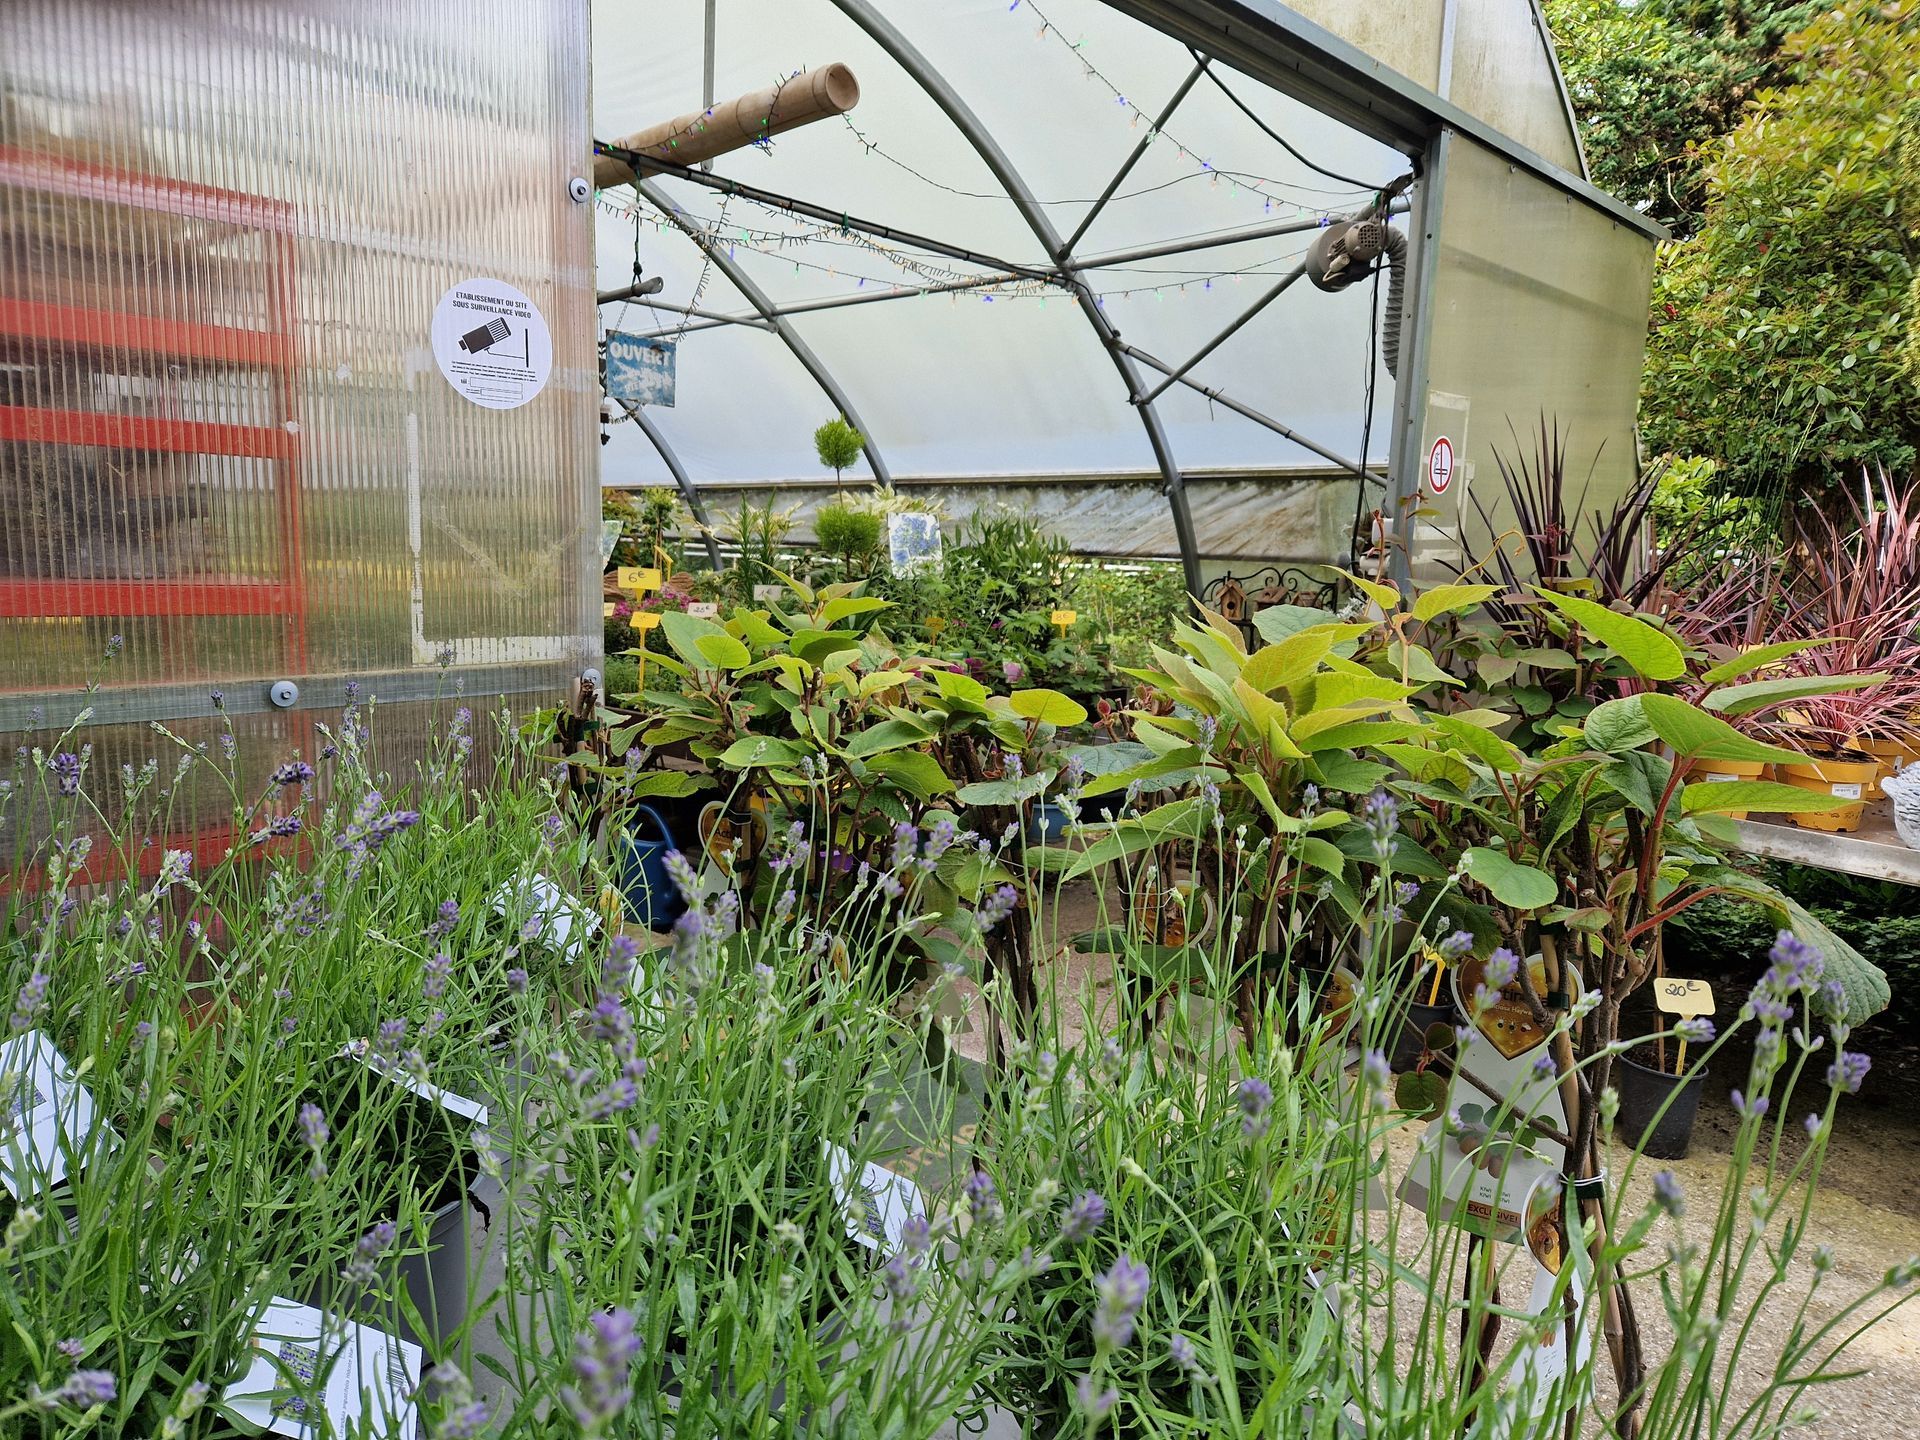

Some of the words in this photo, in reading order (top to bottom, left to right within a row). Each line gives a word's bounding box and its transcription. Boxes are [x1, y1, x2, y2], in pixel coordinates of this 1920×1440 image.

[455, 291, 504, 305] ETABLISSEMENT
[515, 301, 528, 309] SITE
[452, 300, 469, 309] SOUS
[470, 302, 513, 316] SURVEILLANCE
[514, 309, 532, 319] VIDEO
[609, 341, 672, 367] OUVERT
[1664, 980, 1701, 997] 20€
